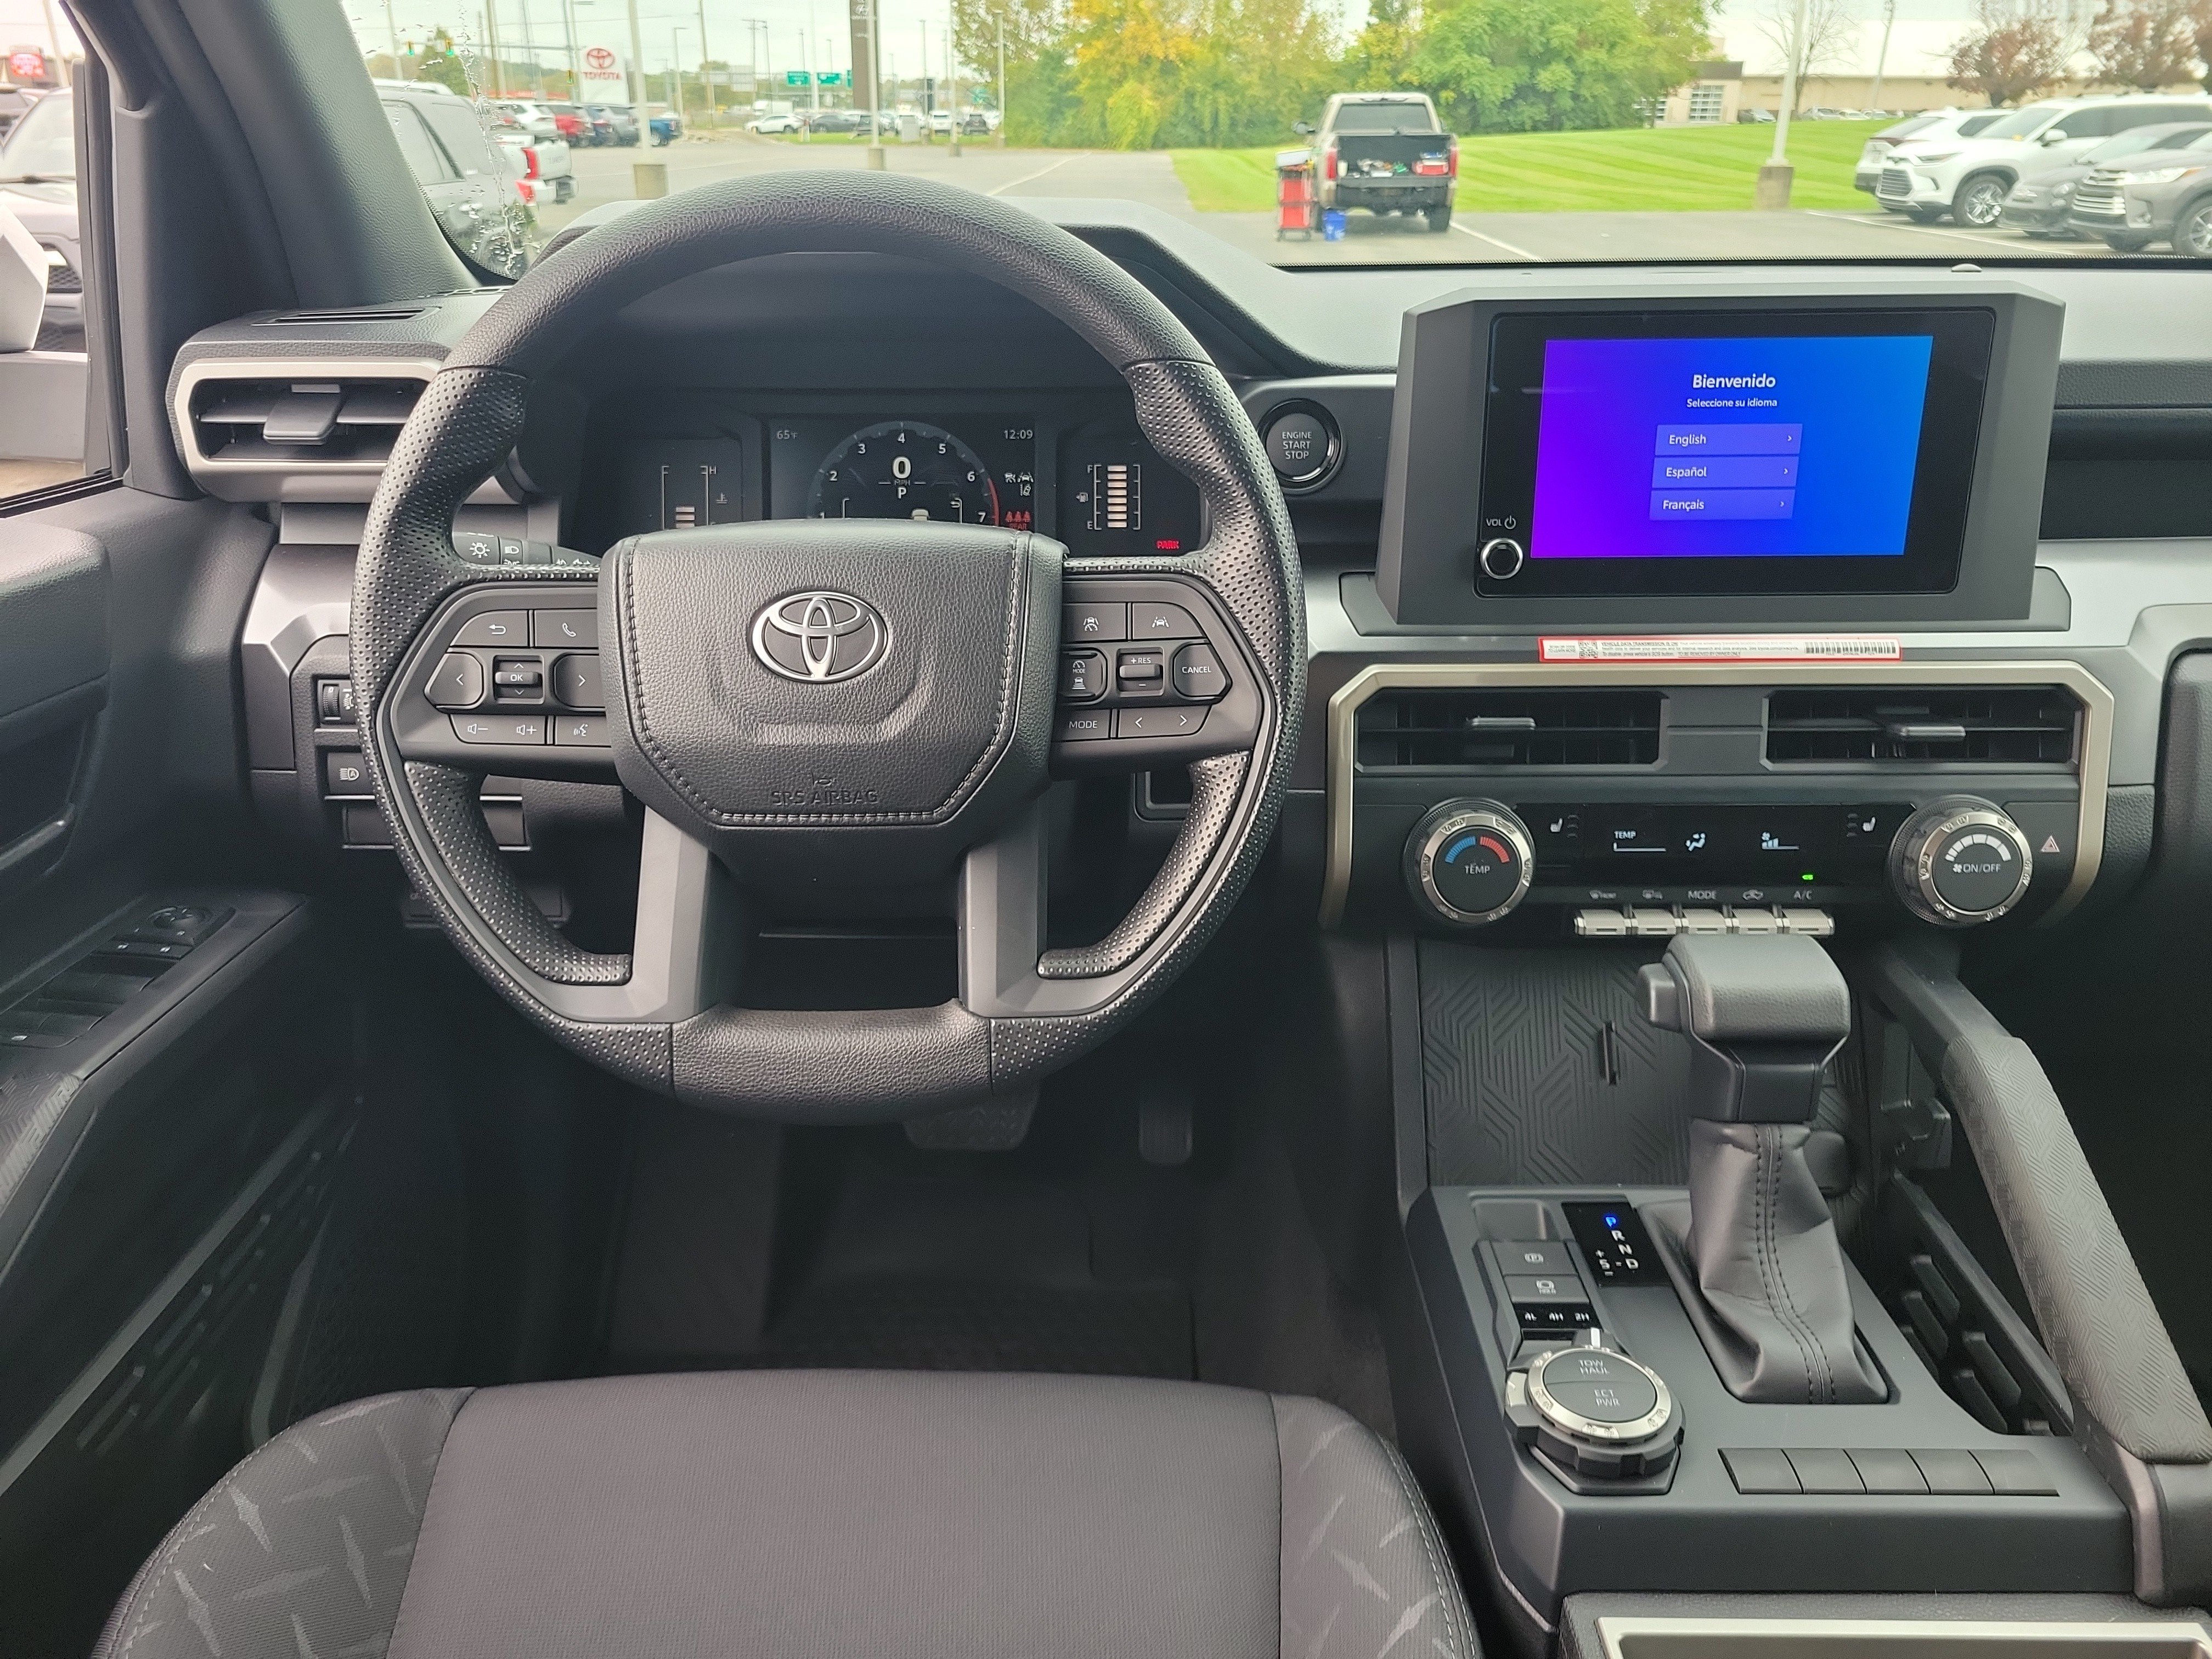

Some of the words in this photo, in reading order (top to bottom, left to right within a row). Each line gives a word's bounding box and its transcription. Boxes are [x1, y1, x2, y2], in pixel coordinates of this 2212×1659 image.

[582, 71, 622, 80] TOYOTA
[1692, 373, 1776, 388] Bienvenido
[1686, 398, 1734, 408] Seleccione
[1747, 398, 1778, 407] idioma
[898, 433, 906, 443] 4
[1004, 429, 1033, 439] 12:09
[1283, 441, 1311, 450] START
[1668, 434, 1707, 447] English
[857, 444, 866, 454] 3
[938, 443, 946, 454] 5
[1285, 450, 1309, 460] STOP
[709, 466, 716, 475] H
[891, 456, 911, 479] 0
[1087, 465, 1093, 473] F
[1666, 466, 1707, 479] Español
[830, 471, 838, 482] 2
[967, 471, 975, 482] 6
[898, 486, 907, 499] P
[1662, 499, 1705, 512] Français
[978, 512, 986, 523] 7
[1486, 518, 1503, 527] VOL
[1087, 521, 1093, 530] E
[1182, 665, 1211, 674] CANCEL
[1069, 721, 1098, 729] MODE
[771, 791, 806, 806] SRS
[810, 790, 878, 805] AIRBAG
[1613, 830, 1636, 839] TEMP
[1464, 864, 1491, 874] TEMP
[1963, 863, 2001, 873] ON/OFF
[1688, 890, 1717, 900] MODE
[1794, 890, 1812, 900] A/C
[1605, 1216, 1617, 1227] P
[1611, 1230, 1626, 1242] R
[1618, 1244, 1633, 1255] N
[1625, 1258, 1639, 1269] D
[1579, 1367, 1610, 1375] HAUL
[1594, 1389, 1613, 1397] ECT
[1595, 1398, 1621, 1407] PWR
